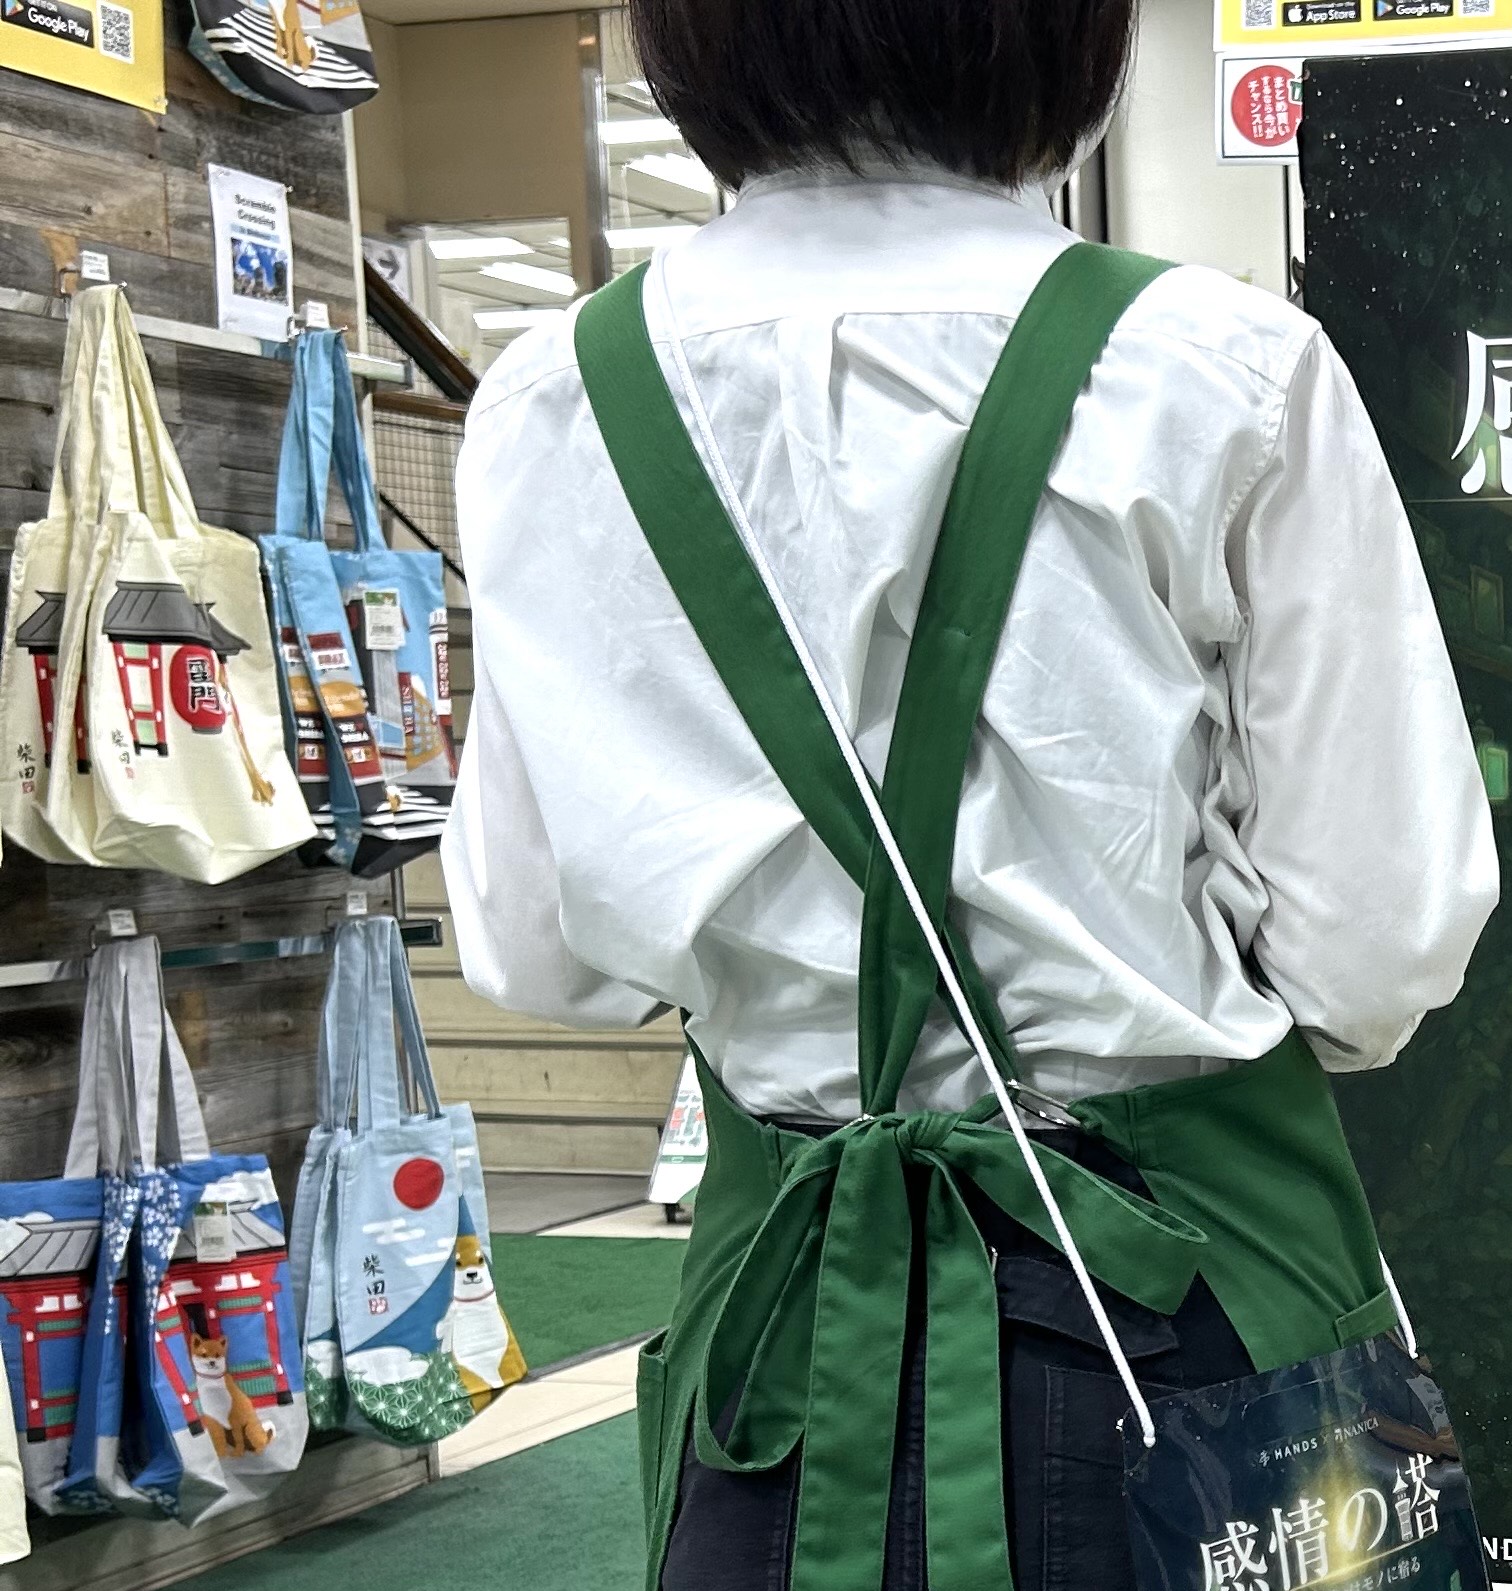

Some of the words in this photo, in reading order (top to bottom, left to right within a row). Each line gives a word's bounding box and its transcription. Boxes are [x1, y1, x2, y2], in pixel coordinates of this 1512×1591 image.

[1305, 11, 1328, 23] App
[1328, 9, 1356, 21] Store
[1395, 3, 1429, 16] Google
[1430, 3, 1451, 15] Play
[27, 8, 68, 34] Google
[67, 19, 90, 43] Play
[1274, 1437, 1318, 1461] HANDS
[1343, 1416, 1379, 1440] NANICA
